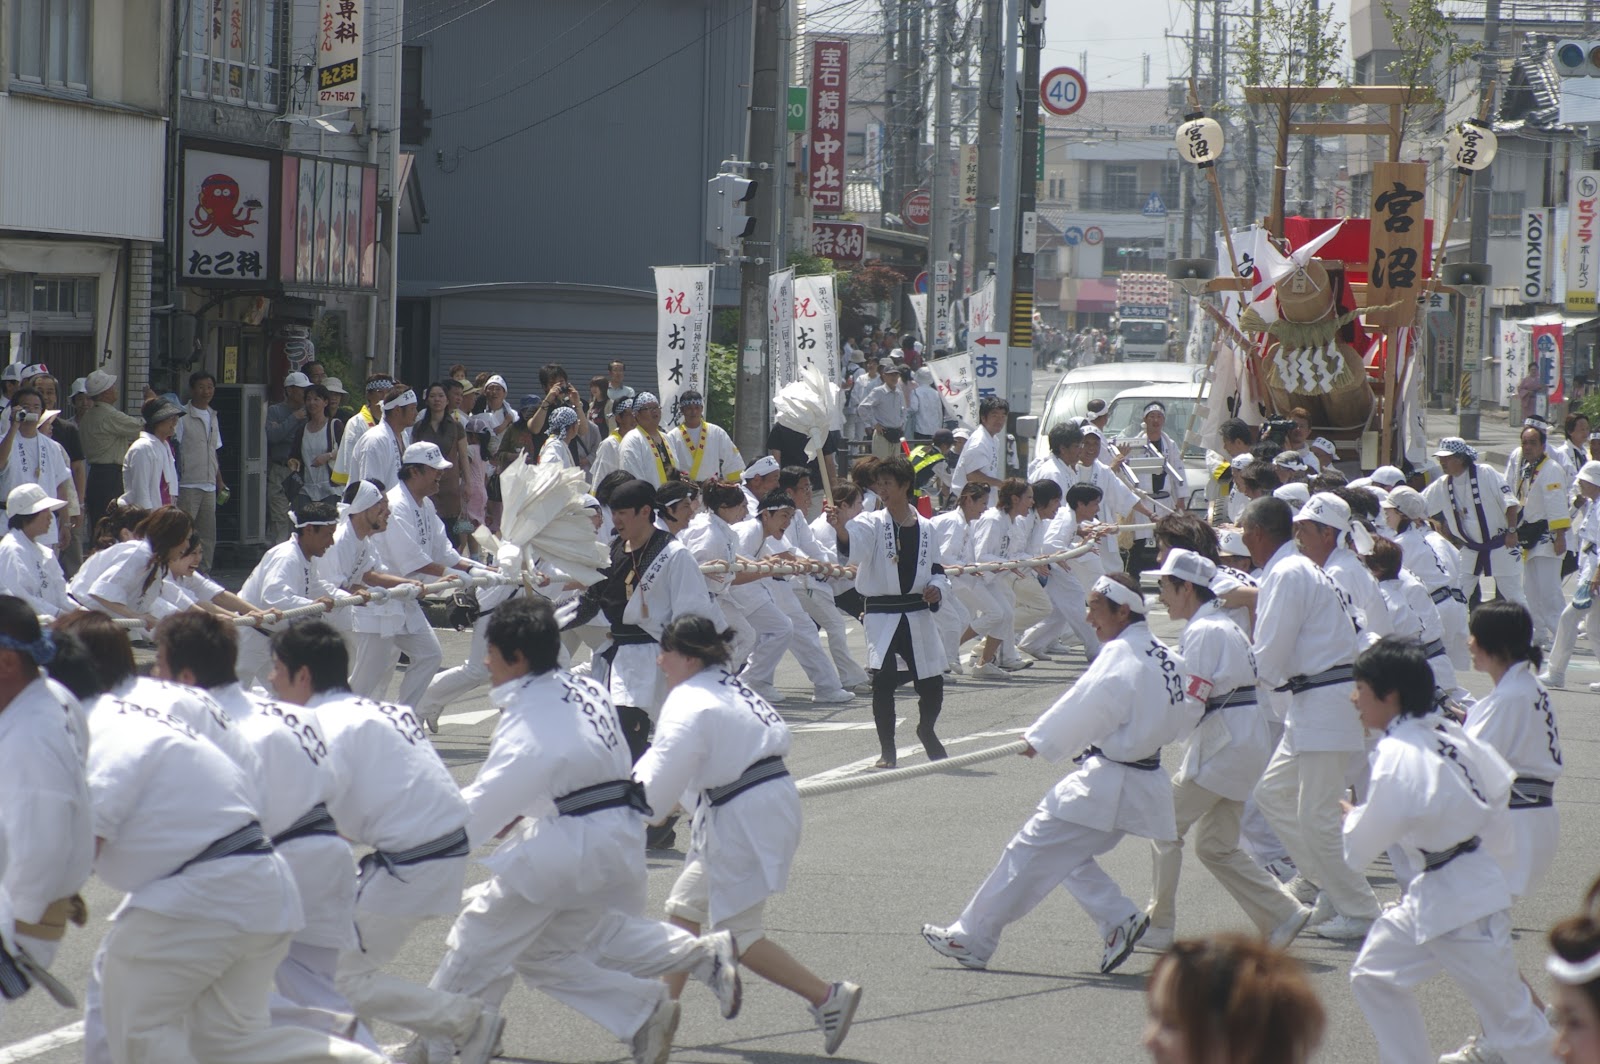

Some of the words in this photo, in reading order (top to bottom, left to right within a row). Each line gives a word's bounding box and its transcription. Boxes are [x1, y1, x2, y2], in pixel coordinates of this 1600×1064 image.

[321, 63, 355, 87] たこ科
[820, 48, 841, 87] 宝石
[1049, 81, 1077, 102] 40
[1185, 123, 1209, 159] 宮沼
[1457, 130, 1483, 165] 宮沼
[814, 134, 841, 188] 中北
[1371, 181, 1425, 290] 宮沼
[1578, 197, 1598, 243] ゼブラ
[812, 227, 863, 257] 結納
[1525, 213, 1543, 298] KOKUYO
[188, 249, 263, 277] たこ科
